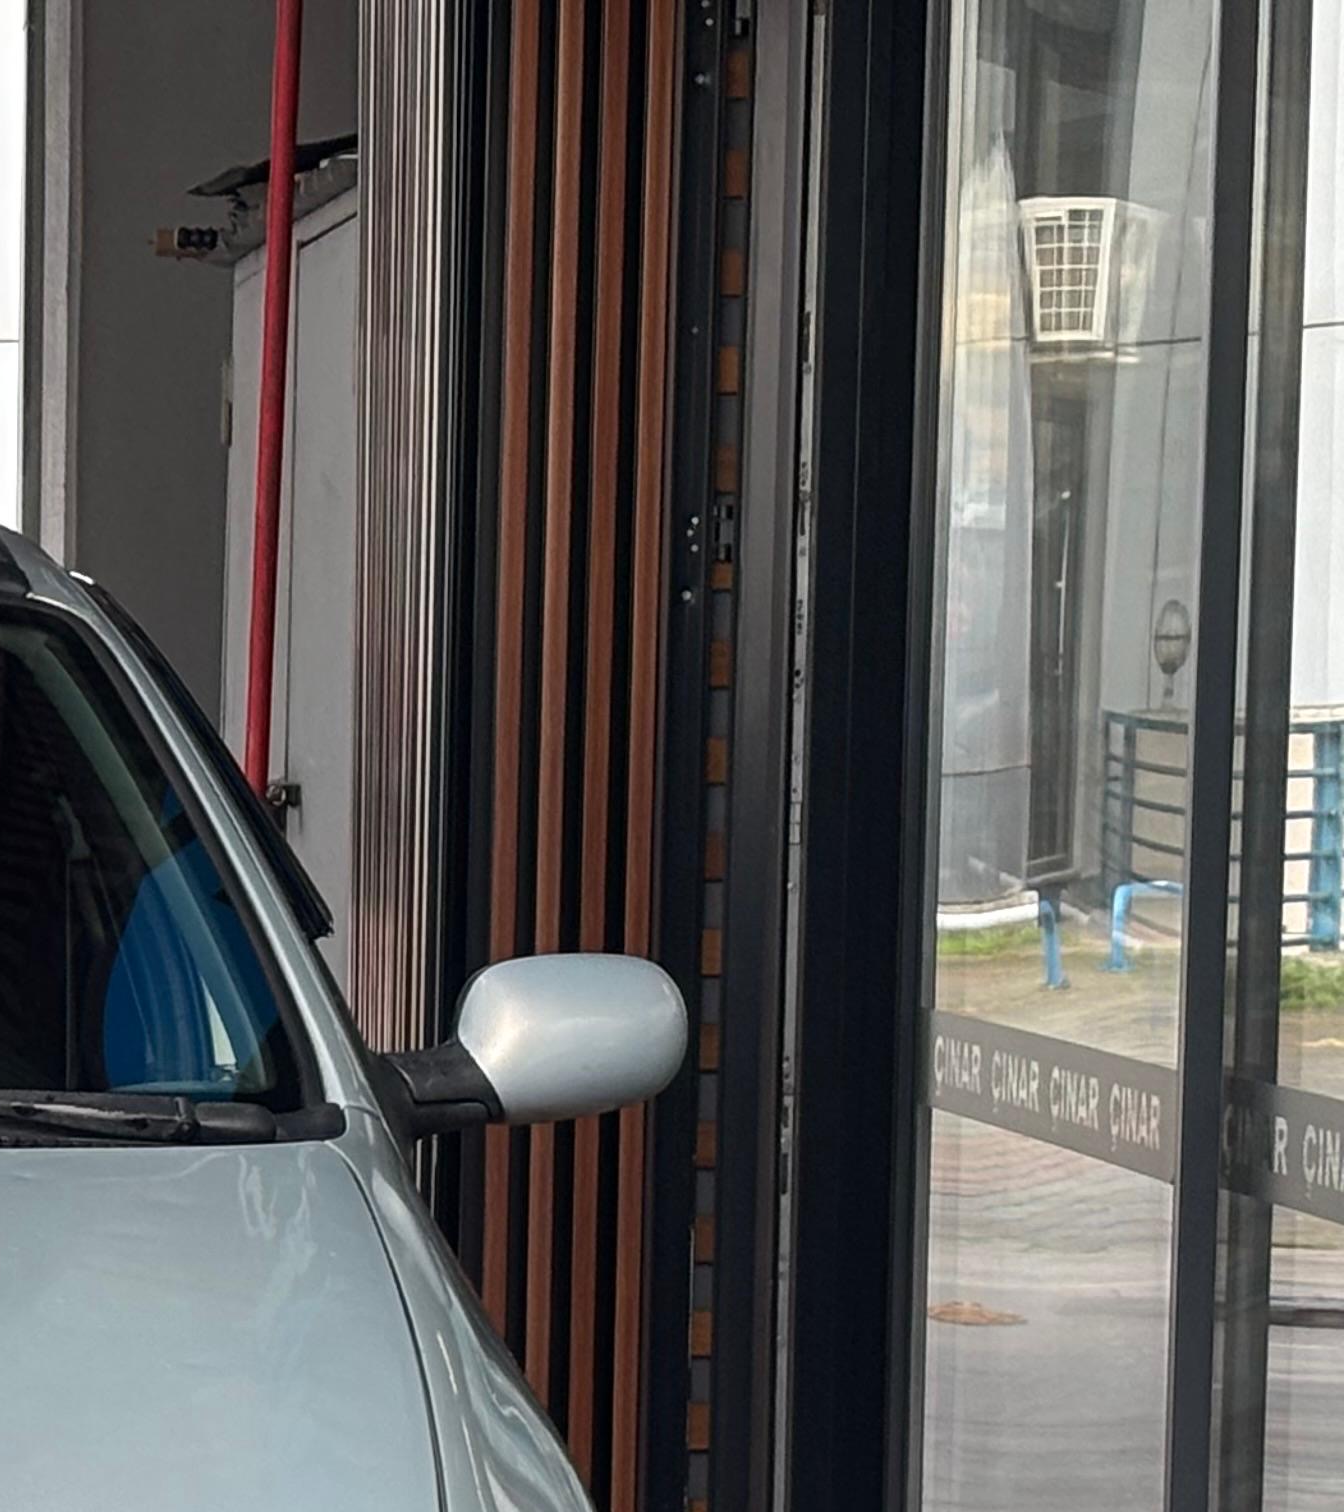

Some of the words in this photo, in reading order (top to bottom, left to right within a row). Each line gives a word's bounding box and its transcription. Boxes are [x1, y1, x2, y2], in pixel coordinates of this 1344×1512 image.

[934, 1035, 981, 1096] ÇINAR
[991, 1050, 1040, 1112] ÇINAR
[1049, 1065, 1099, 1132] ÇINAR
[1110, 1081, 1161, 1152] ÇINAR
